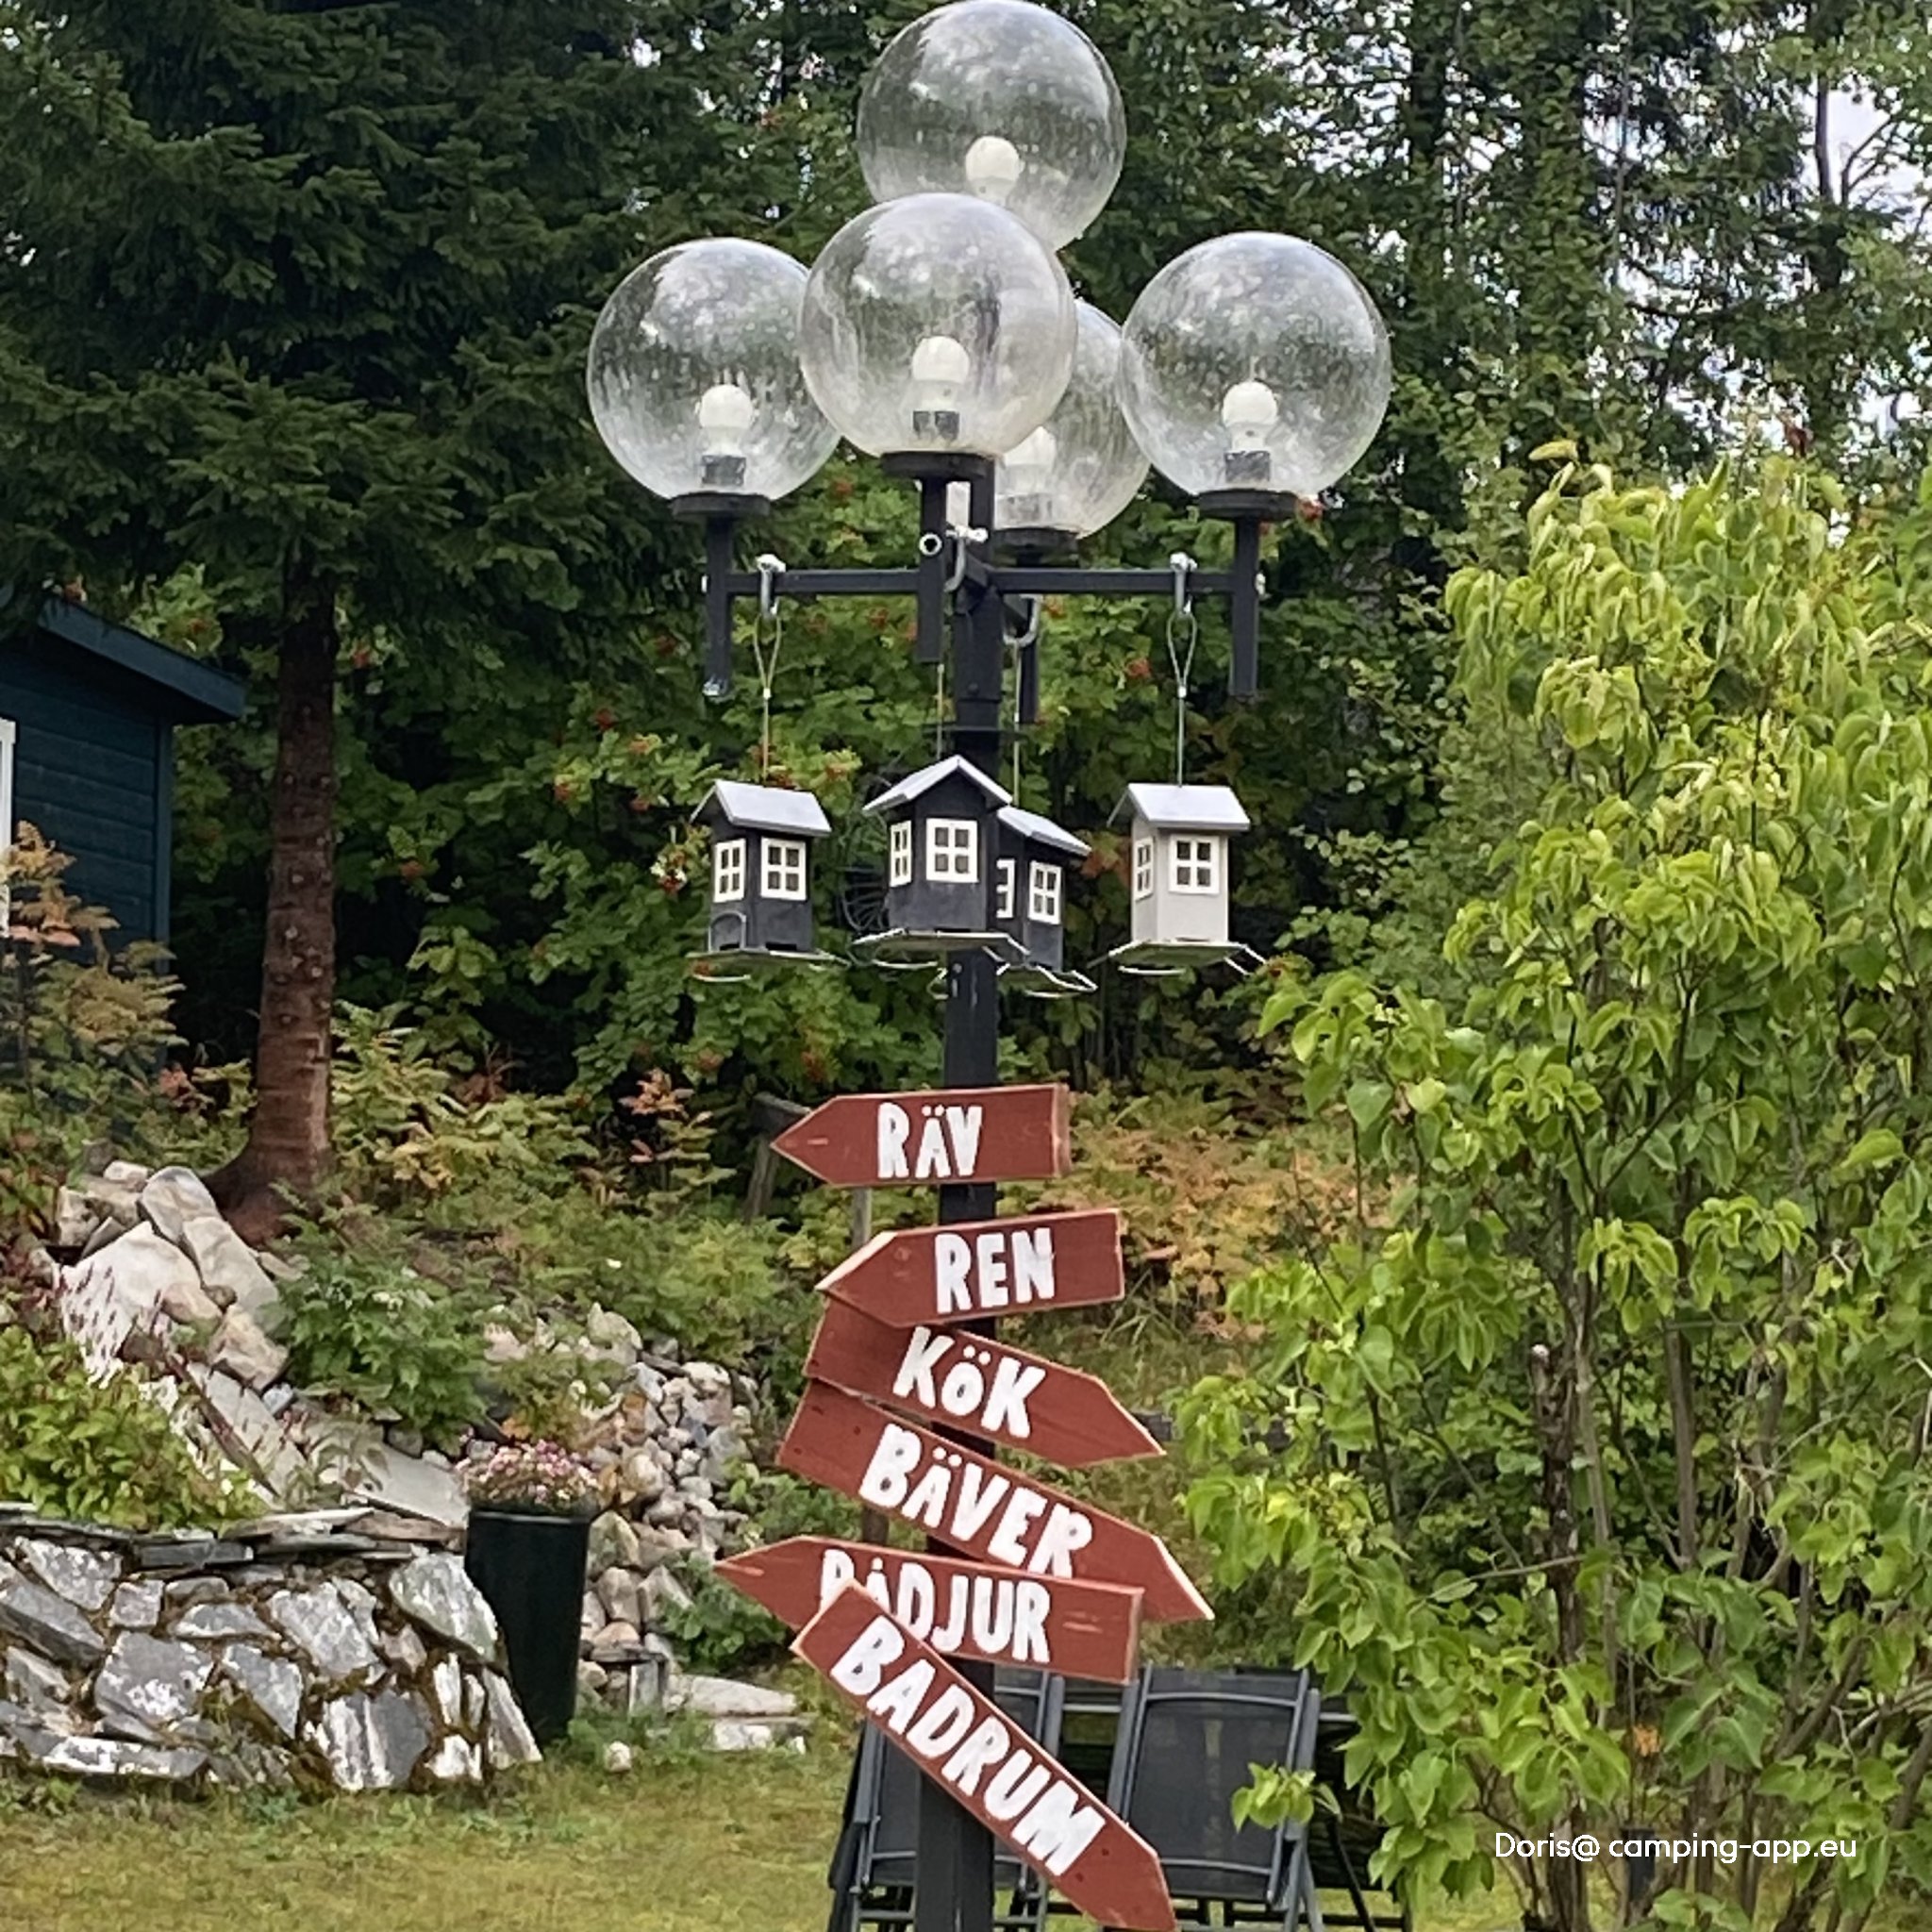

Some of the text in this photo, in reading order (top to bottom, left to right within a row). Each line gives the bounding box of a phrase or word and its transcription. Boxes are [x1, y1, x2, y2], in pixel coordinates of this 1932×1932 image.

[877, 1102, 983, 1178] RÄV
[934, 1228, 1056, 1313] REN
[892, 1326, 1045, 1439] KÖK
[858, 1423, 1092, 1579] BÄVER
[829, 1616, 1106, 1876] BADRUM
